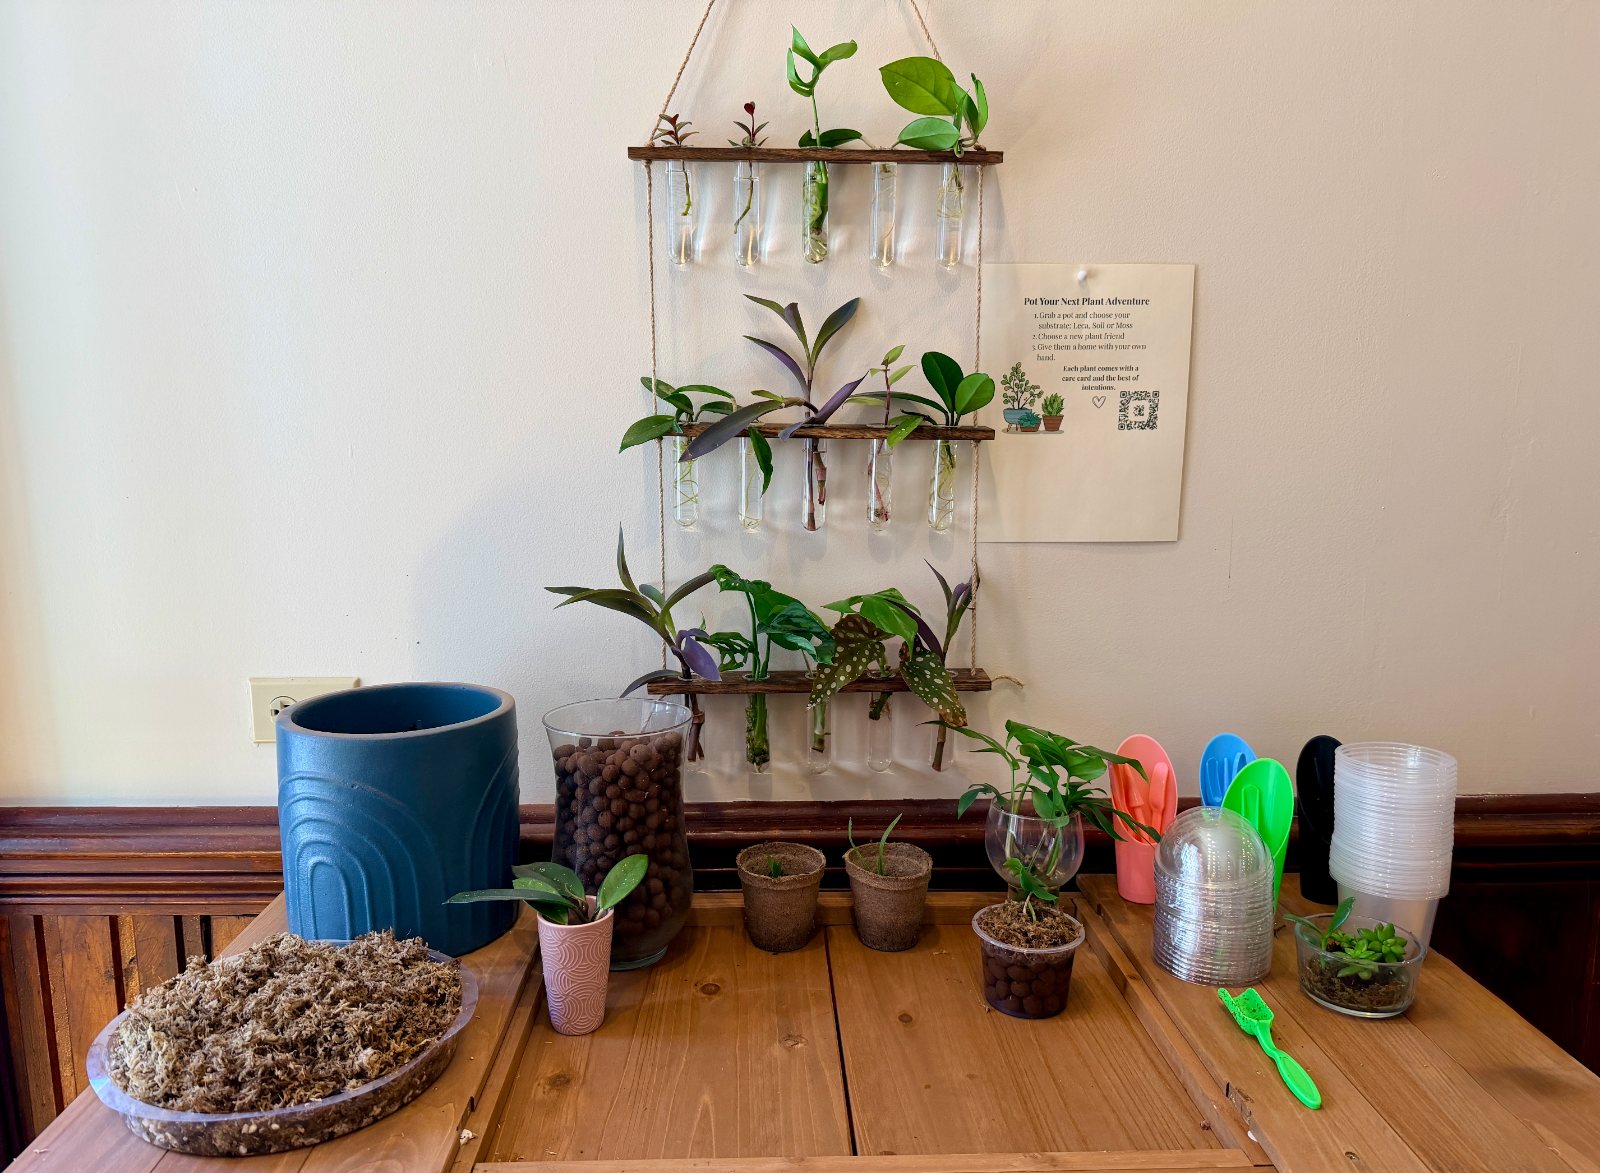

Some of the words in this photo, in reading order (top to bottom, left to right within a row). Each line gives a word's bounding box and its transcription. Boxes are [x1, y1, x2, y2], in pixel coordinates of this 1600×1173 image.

[1024, 298, 1038, 306] Pot
[1039, 298, 1060, 306] Your
[1061, 298, 1080, 306] Next
[1081, 298, 1104, 306] Plant
[1105, 297, 1150, 306] Adventure
[1073, 322, 1091, 330] Leca,
[1084, 333, 1103, 341] plant
[1079, 365, 1097, 373] plant
[1131, 374, 1140, 382] of
